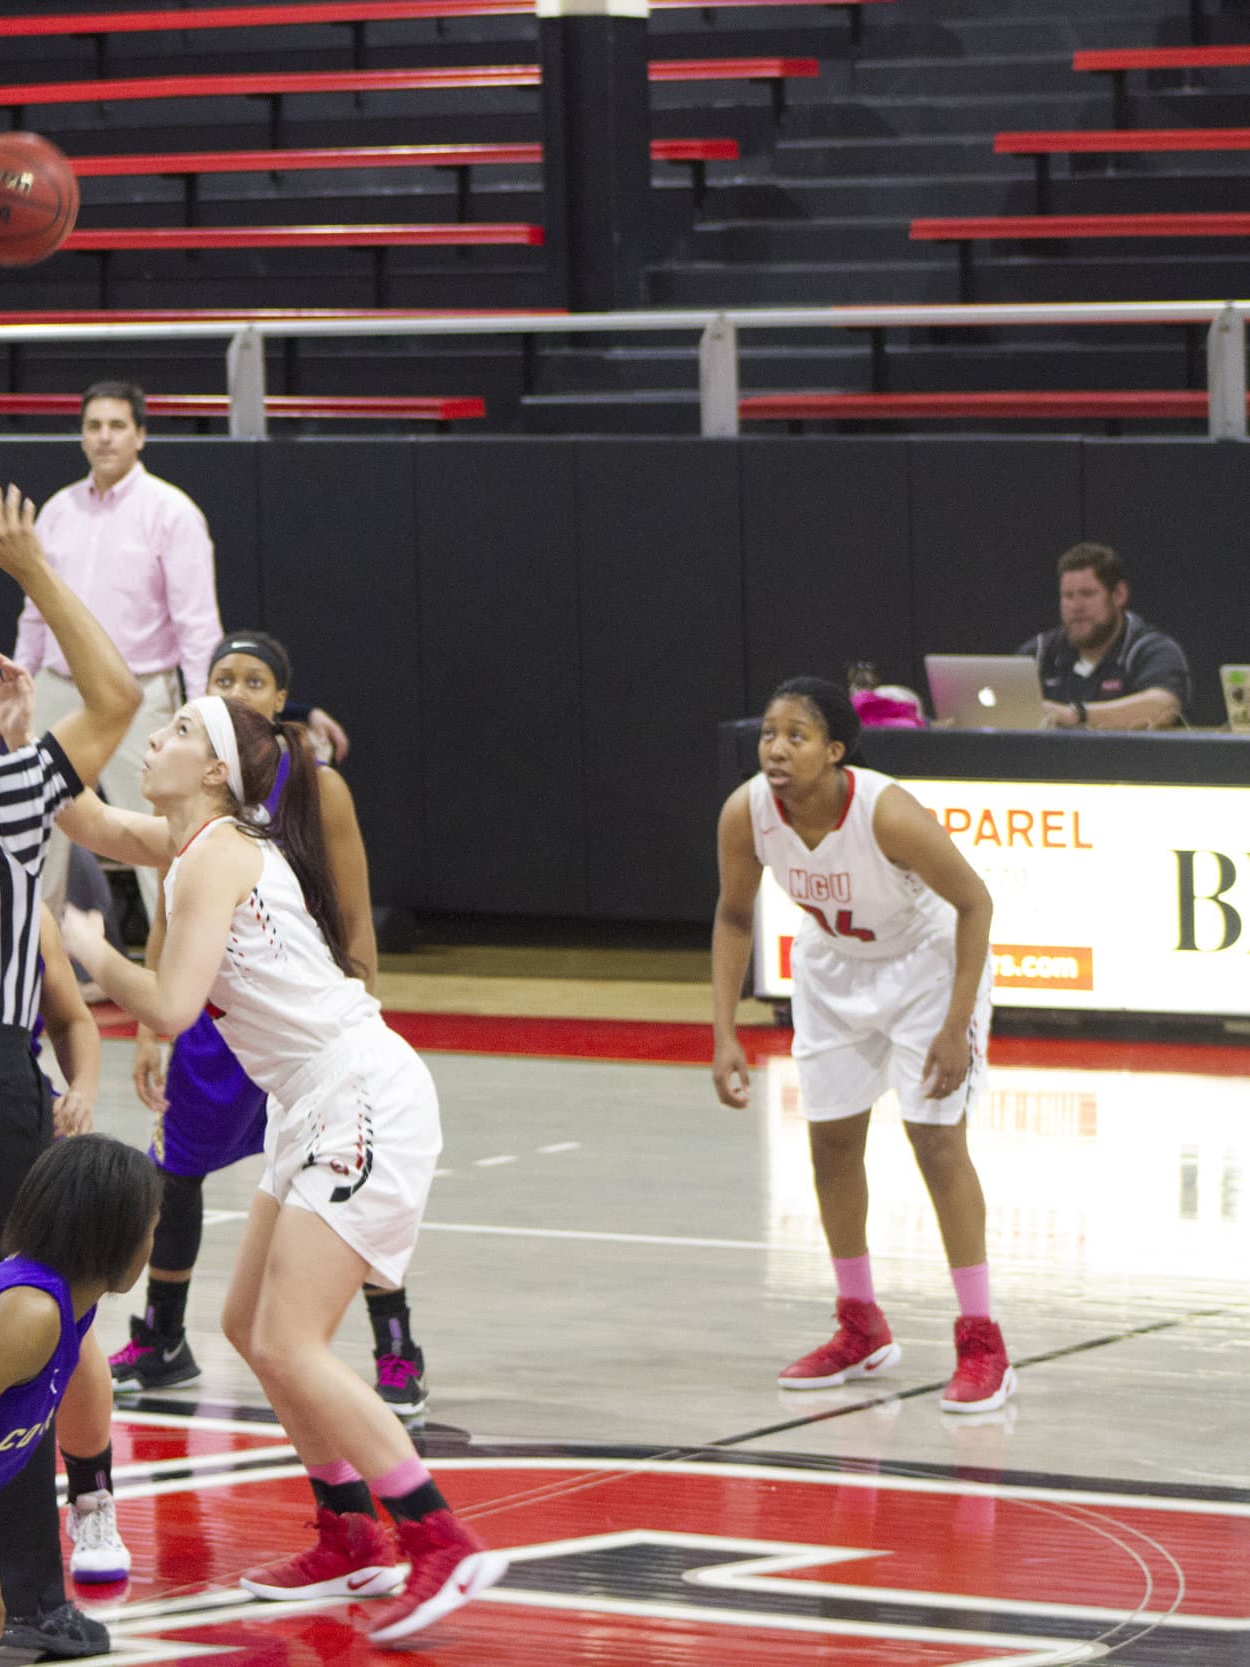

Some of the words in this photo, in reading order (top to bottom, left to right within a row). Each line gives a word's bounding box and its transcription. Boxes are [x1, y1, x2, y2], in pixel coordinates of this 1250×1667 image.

[926, 807, 1094, 849] PAREL
[789, 868, 852, 903] NGU
[1172, 849, 1250, 952] B
[991, 954, 1079, 979] rs.com
